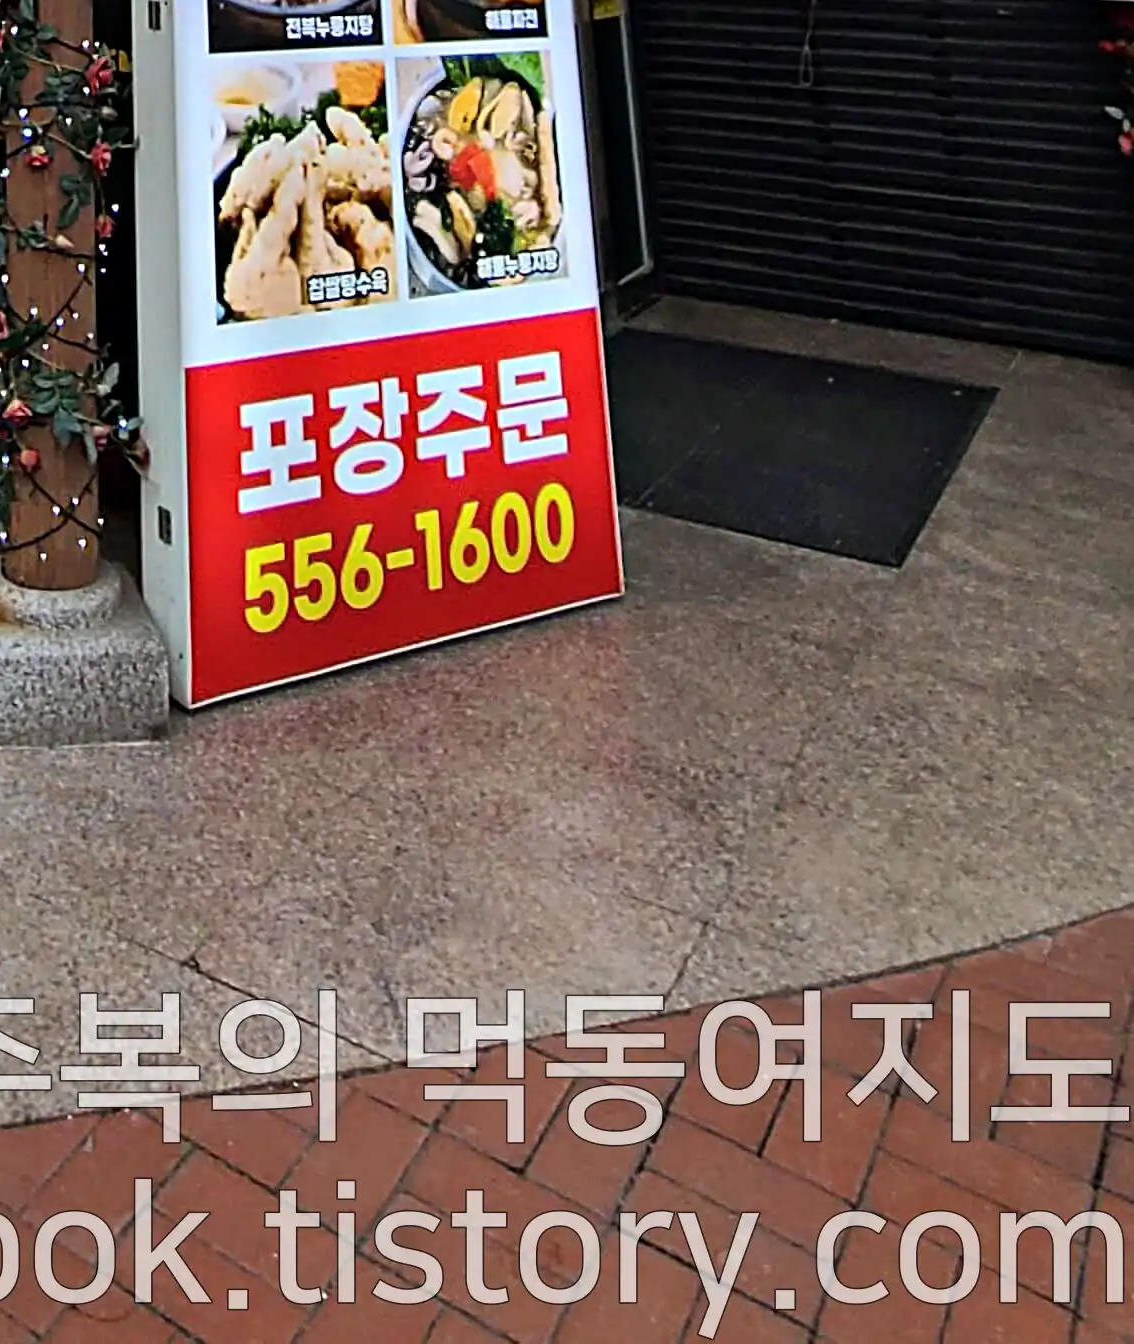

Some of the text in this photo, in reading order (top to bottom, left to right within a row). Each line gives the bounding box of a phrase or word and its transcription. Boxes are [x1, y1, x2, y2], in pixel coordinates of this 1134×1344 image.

[285, 15, 374, 40] 전복누룽지탕
[238, 350, 568, 515] 포장주문
[244, 482, 575, 634] 556-1600
